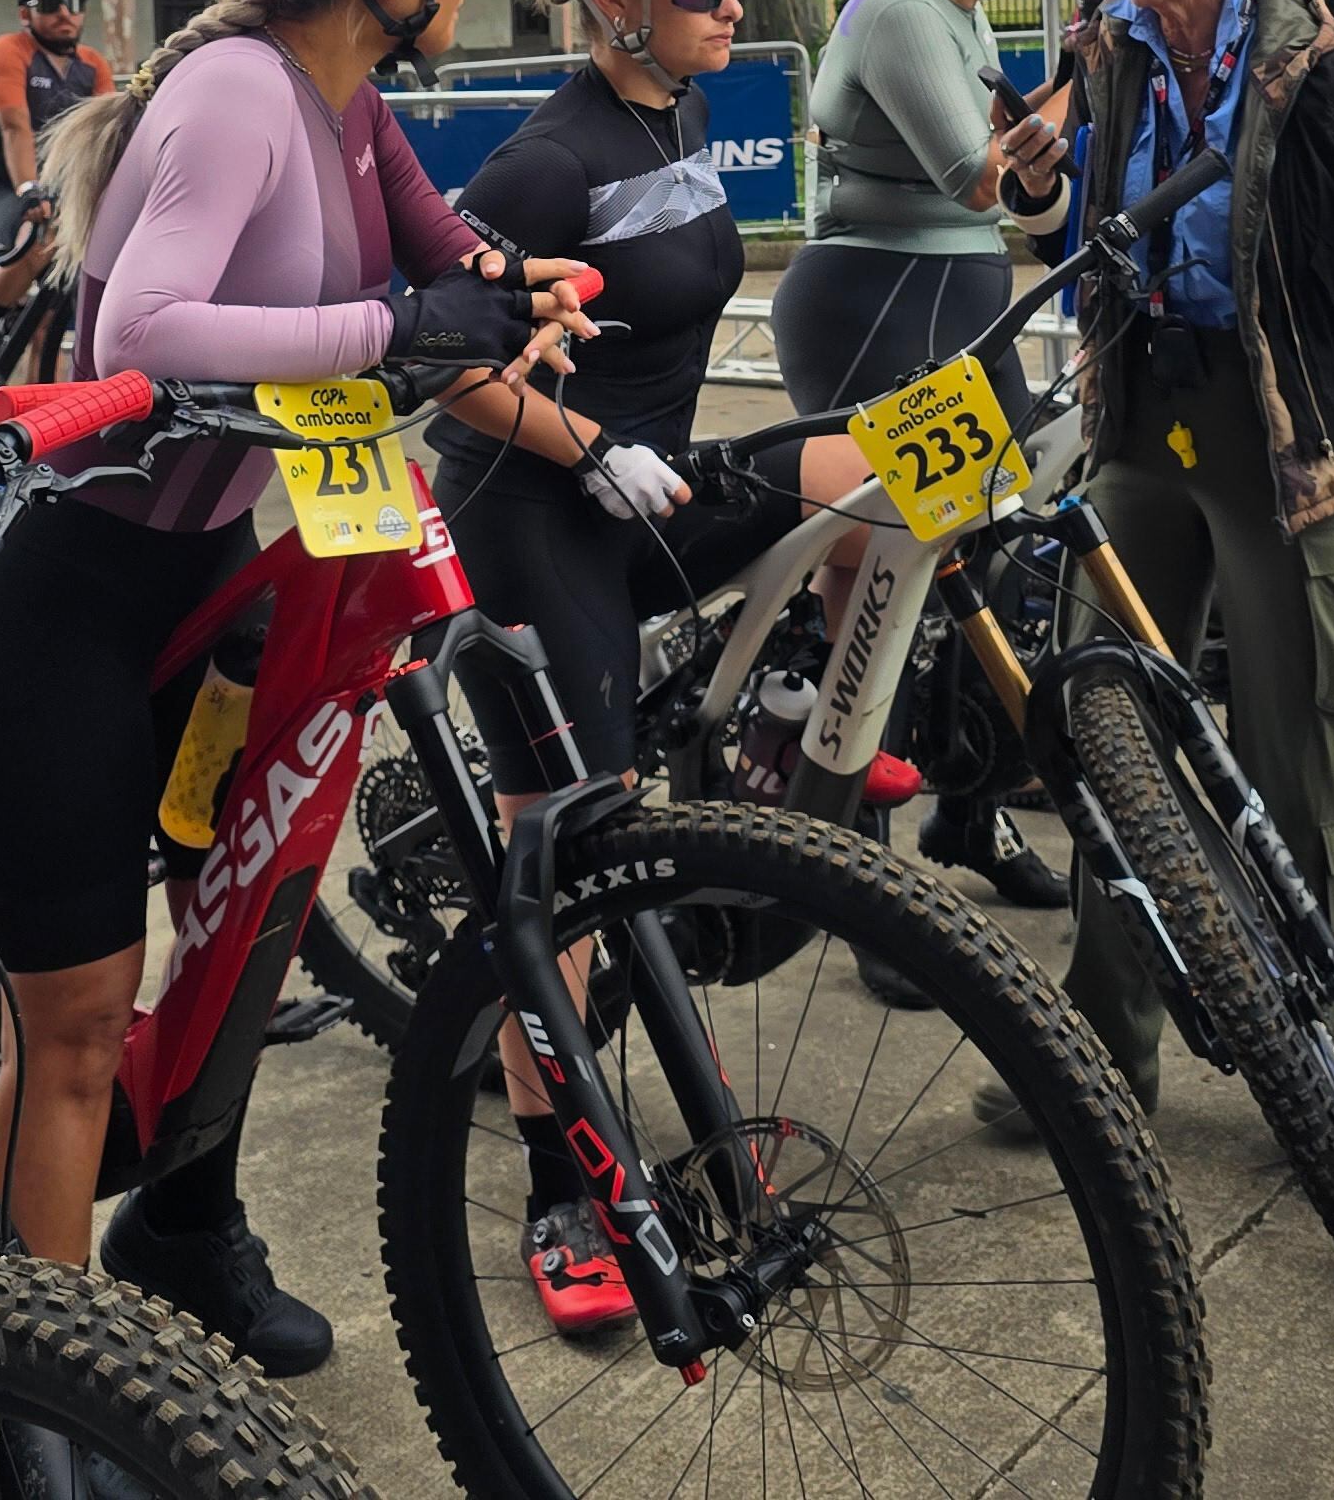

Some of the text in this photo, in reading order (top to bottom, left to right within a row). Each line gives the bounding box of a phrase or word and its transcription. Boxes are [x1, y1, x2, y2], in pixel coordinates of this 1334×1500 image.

[711, 138, 784, 166] INS
[295, 410, 372, 428] ambacar
[311, 388, 348, 407] COPA
[886, 392, 964, 441] ambacar
[898, 385, 938, 416] COPA
[306, 436, 392, 497] 231
[895, 412, 995, 494] 233
[819, 556, 896, 761] S-WORKS
[157, 701, 353, 1005] ASGAS
[553, 858, 677, 916] AXXIS
